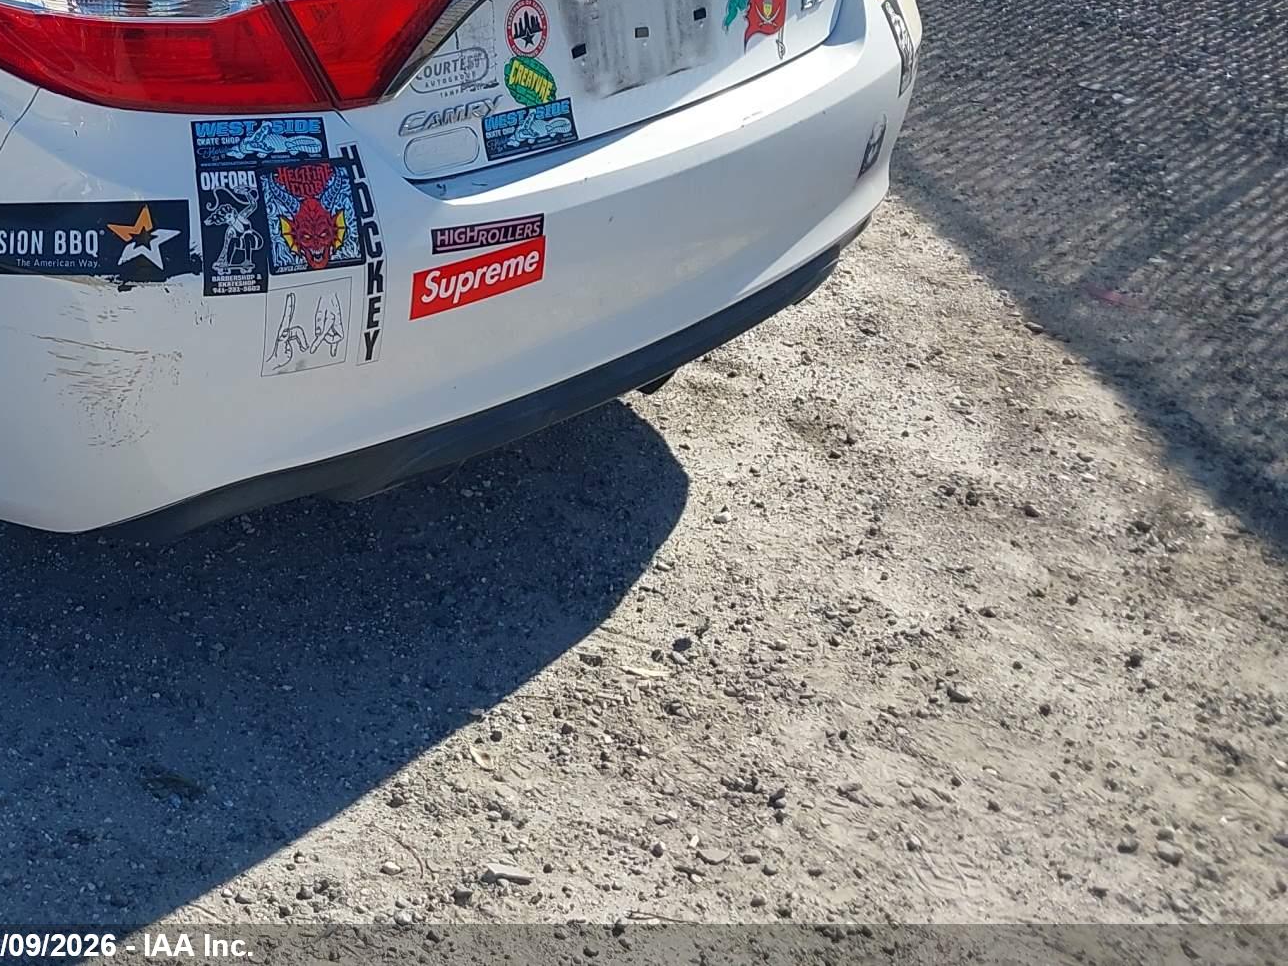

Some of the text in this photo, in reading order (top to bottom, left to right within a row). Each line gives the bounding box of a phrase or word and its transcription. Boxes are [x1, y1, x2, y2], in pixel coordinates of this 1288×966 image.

[508, 60, 554, 104] CREATURE
[195, 119, 322, 138] WEST SIDE
[398, 95, 504, 136] CAMRY
[485, 99, 570, 131] WEST SIDE
[196, 136, 240, 146] SKATE SHOP
[200, 170, 258, 191] OXFORD
[54, 229, 100, 258] BBQ
[340, 144, 384, 361] HOCKEY
[16, 258, 31, 267] The
[33, 258, 76, 268] American
[420, 250, 540, 304] Supreme
